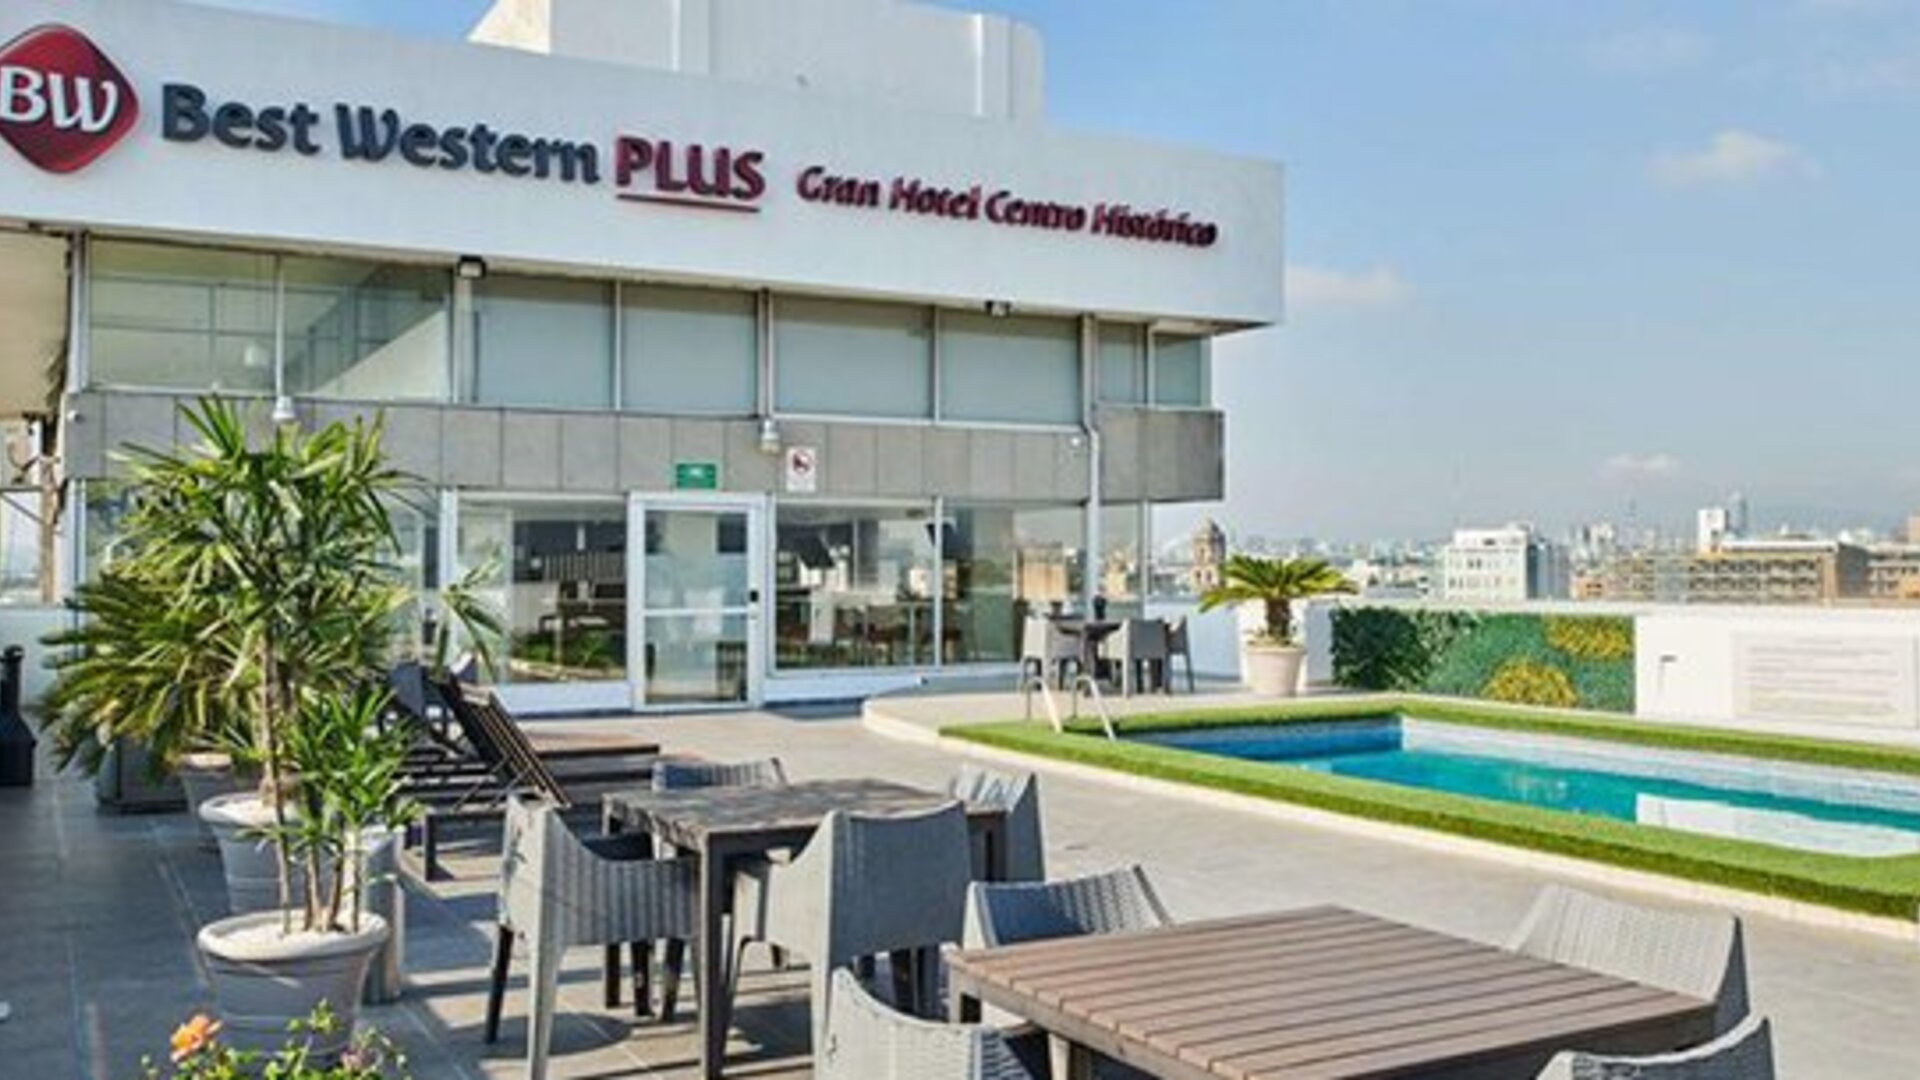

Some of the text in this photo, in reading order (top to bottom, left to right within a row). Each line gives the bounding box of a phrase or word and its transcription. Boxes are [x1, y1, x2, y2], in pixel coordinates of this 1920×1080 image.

[0, 65, 118, 132] BW
[162, 83, 765, 201] Best Western PLUS
[797, 165, 880, 208] Gran
[890, 176, 981, 221] Hotel
[985, 190, 1086, 231] Centro
